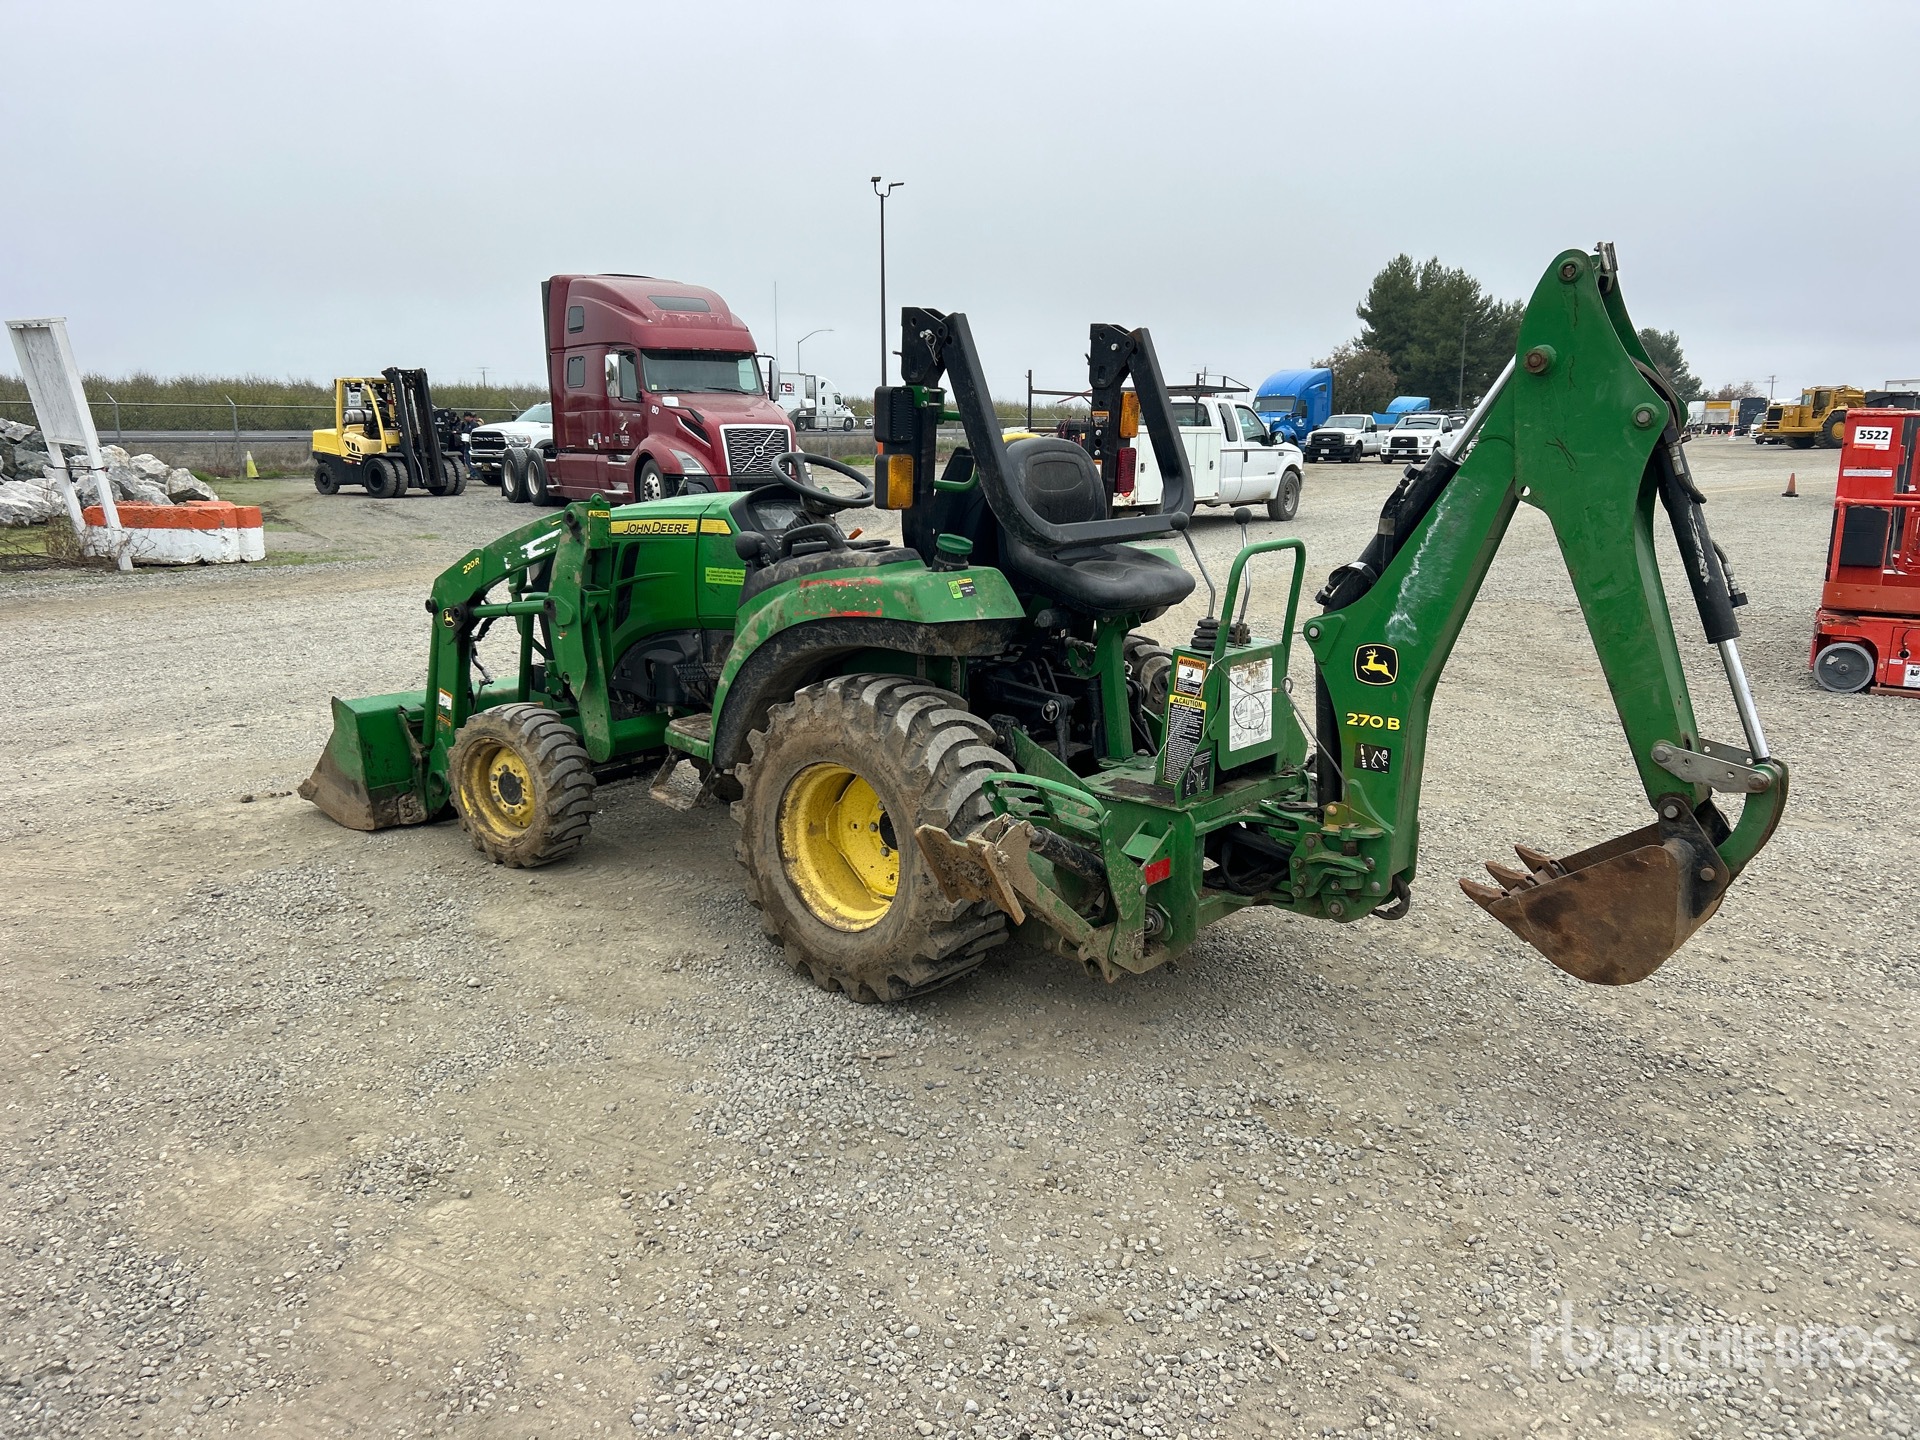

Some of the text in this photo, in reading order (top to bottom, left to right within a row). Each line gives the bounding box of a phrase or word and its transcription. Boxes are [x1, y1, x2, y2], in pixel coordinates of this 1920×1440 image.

[1859, 430, 1889, 441] 5522
[623, 522, 689, 533] JOHN DEERE
[1179, 697, 1203, 709] CAUTION
